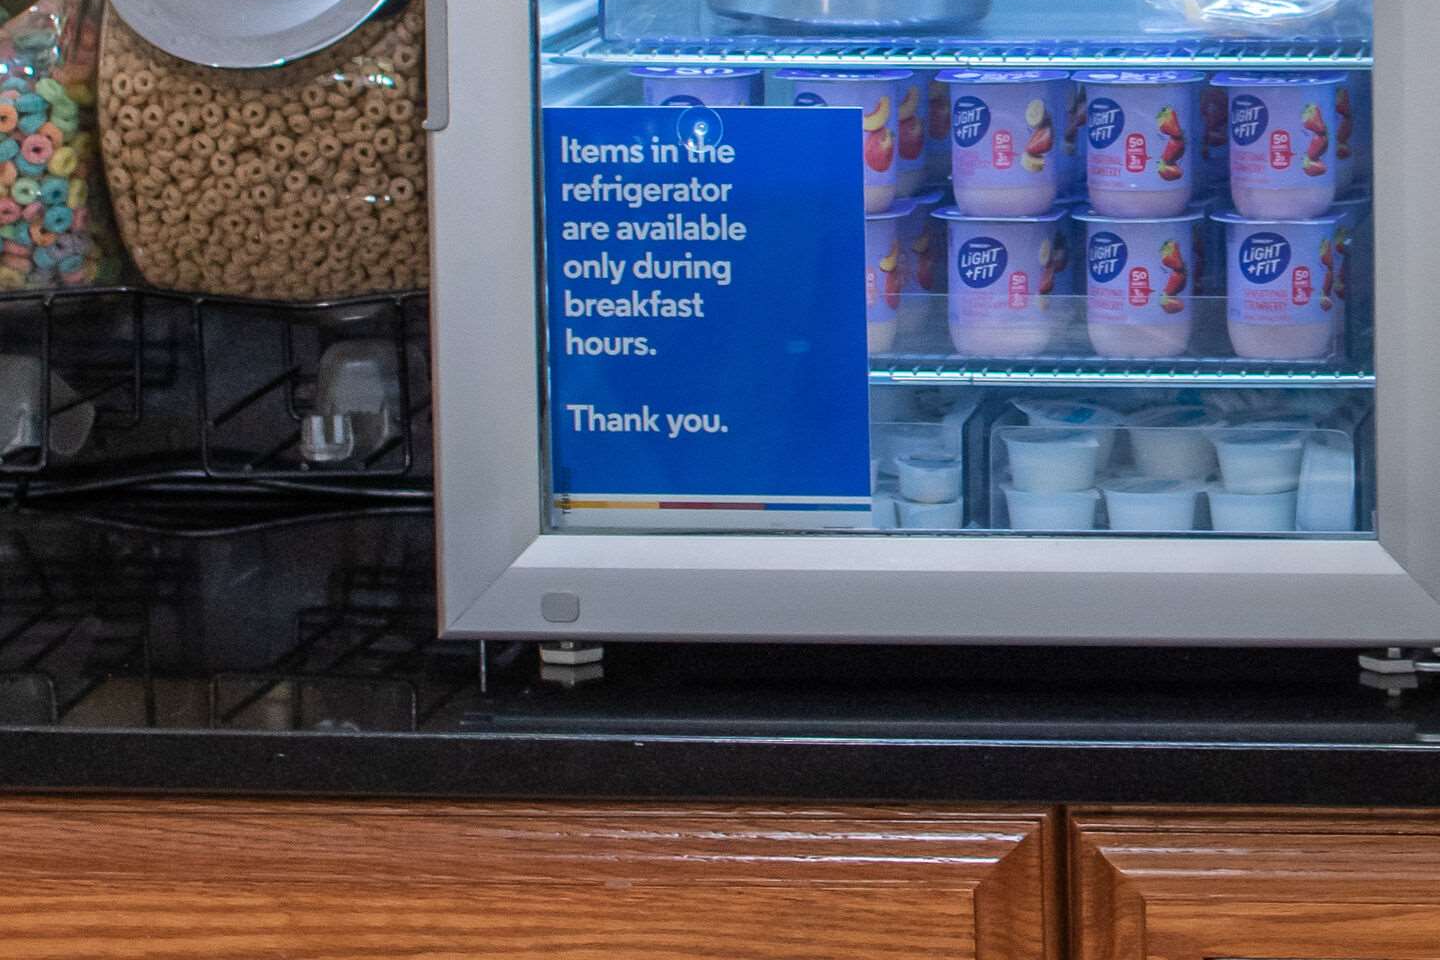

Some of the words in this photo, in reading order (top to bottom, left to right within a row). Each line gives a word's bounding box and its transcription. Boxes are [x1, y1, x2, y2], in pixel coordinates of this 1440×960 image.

[561, 135, 645, 163] Items
[651, 135, 679, 163] in
[687, 136, 736, 164] the
[561, 174, 733, 209] refrigerator
[562, 220, 610, 241] are
[616, 213, 747, 241] available
[563, 251, 627, 285] only
[632, 251, 732, 286] during
[564, 290, 705, 318] breakfast
[565, 328, 657, 356] hours.
[566, 404, 660, 433] Thank
[666, 413, 729, 439] you.
